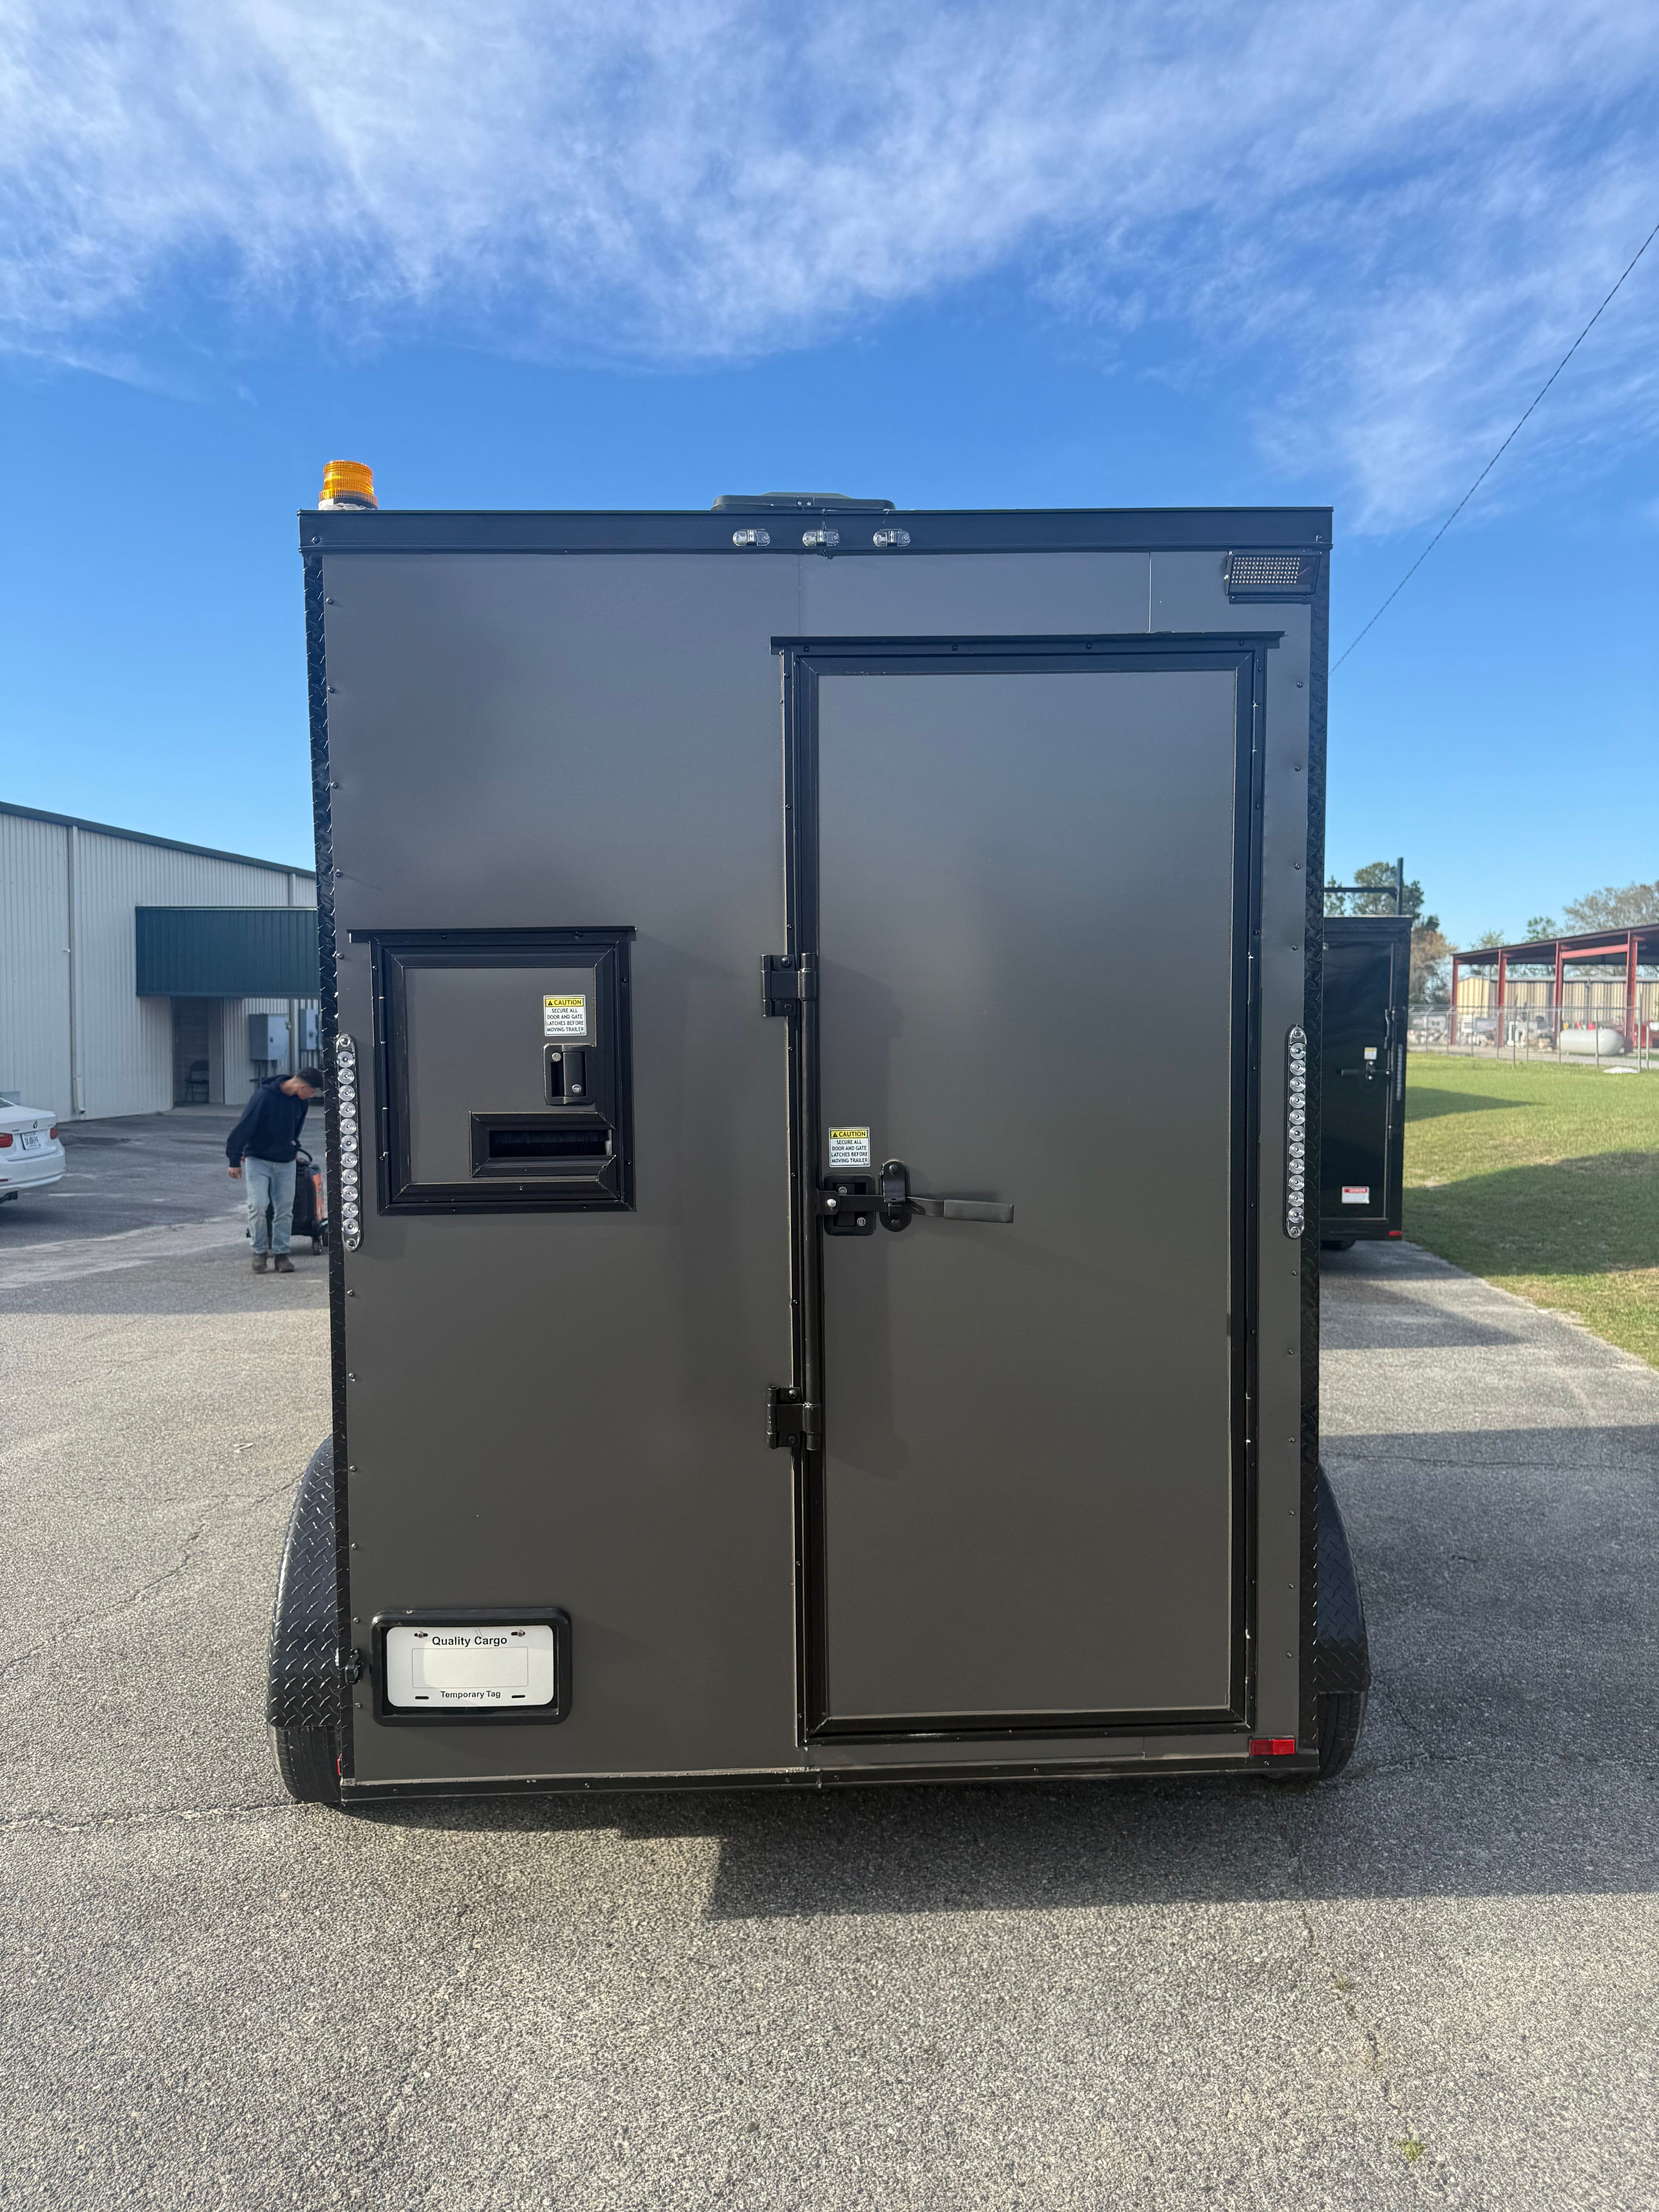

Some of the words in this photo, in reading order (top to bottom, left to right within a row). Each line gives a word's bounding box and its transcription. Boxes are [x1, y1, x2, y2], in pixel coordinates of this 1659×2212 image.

[432, 1637, 470, 1647] Quality
[474, 1636, 507, 1646] Cargo
[440, 1691, 484, 1699] Temporary
